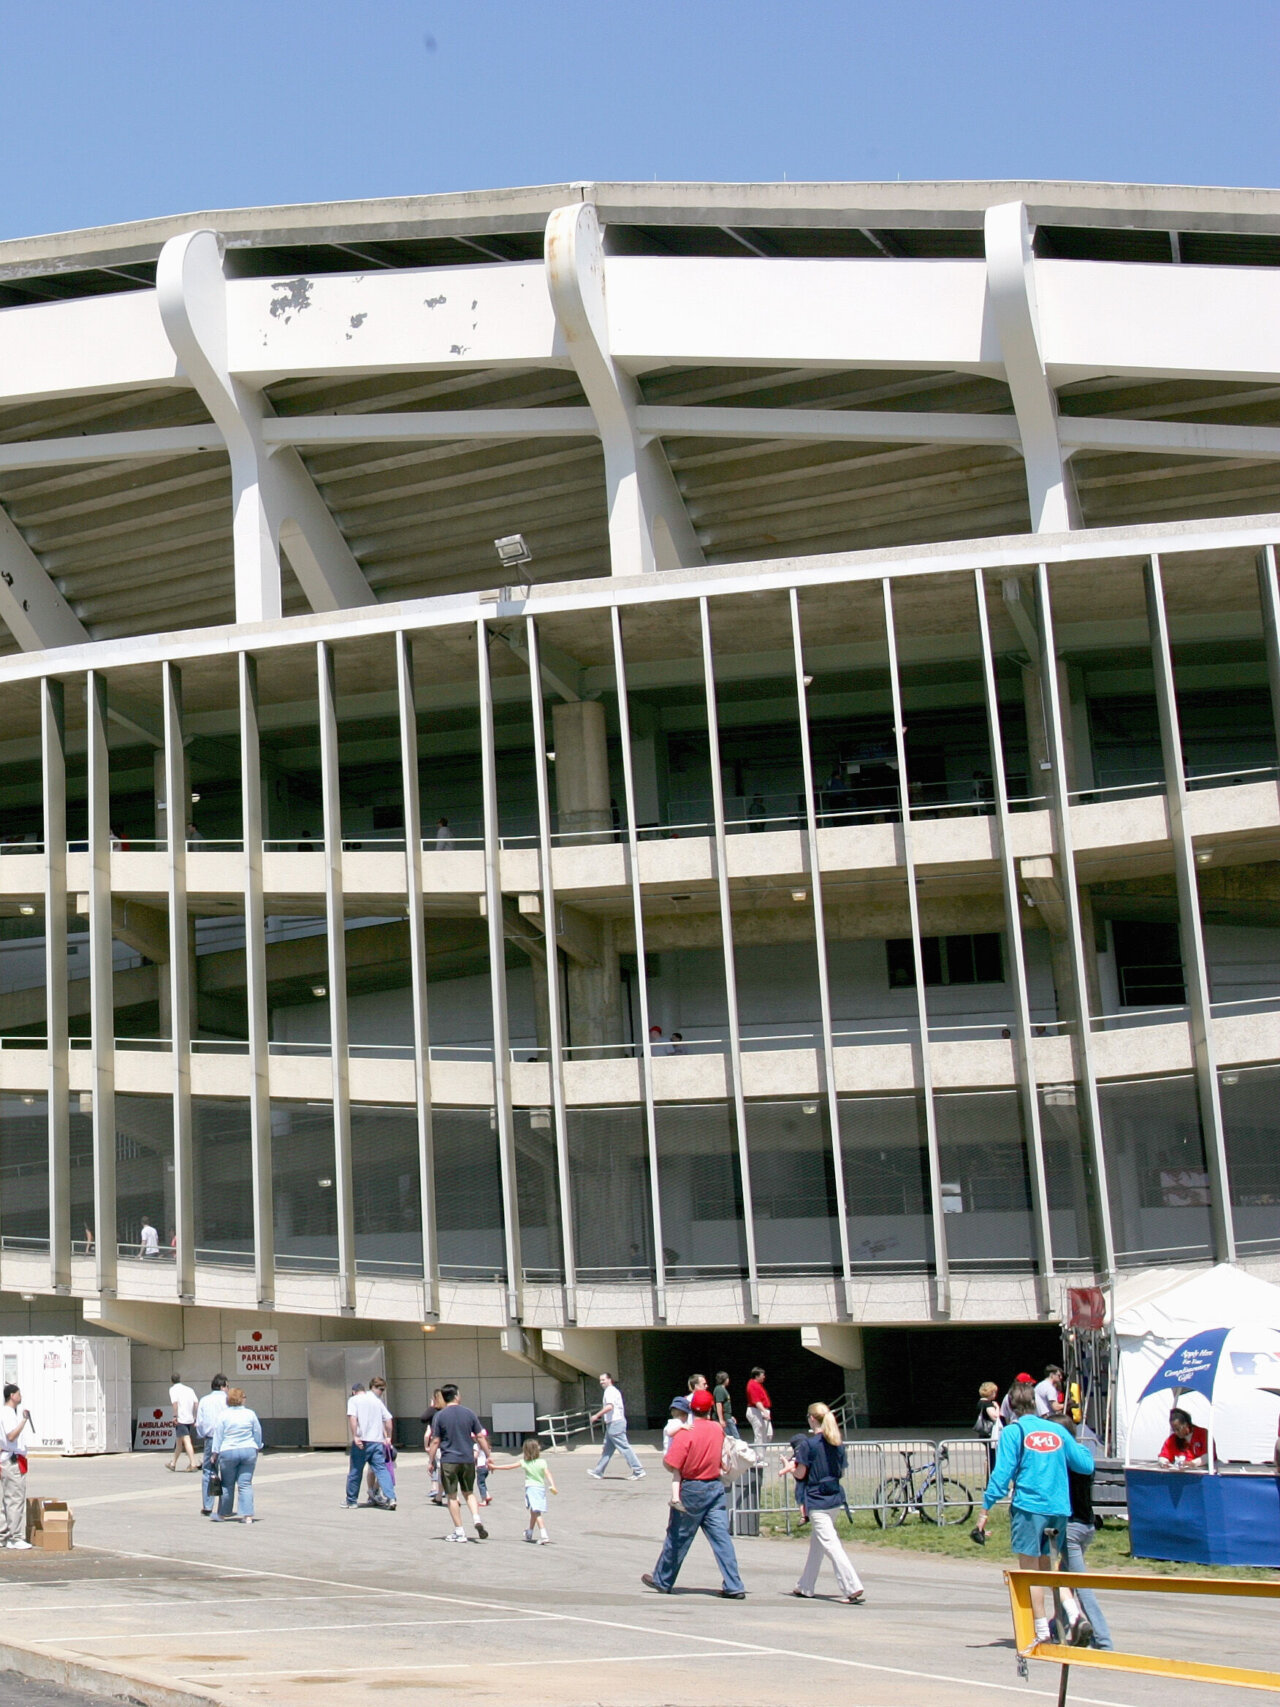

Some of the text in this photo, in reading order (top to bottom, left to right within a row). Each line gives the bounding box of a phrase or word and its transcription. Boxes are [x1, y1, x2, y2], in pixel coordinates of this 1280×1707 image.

[237, 1344, 278, 1352] AMBULANCE
[241, 1354, 275, 1362] PARKING
[245, 1363, 272, 1371] ONLY
[138, 1421, 177, 1429] AMBULANCE
